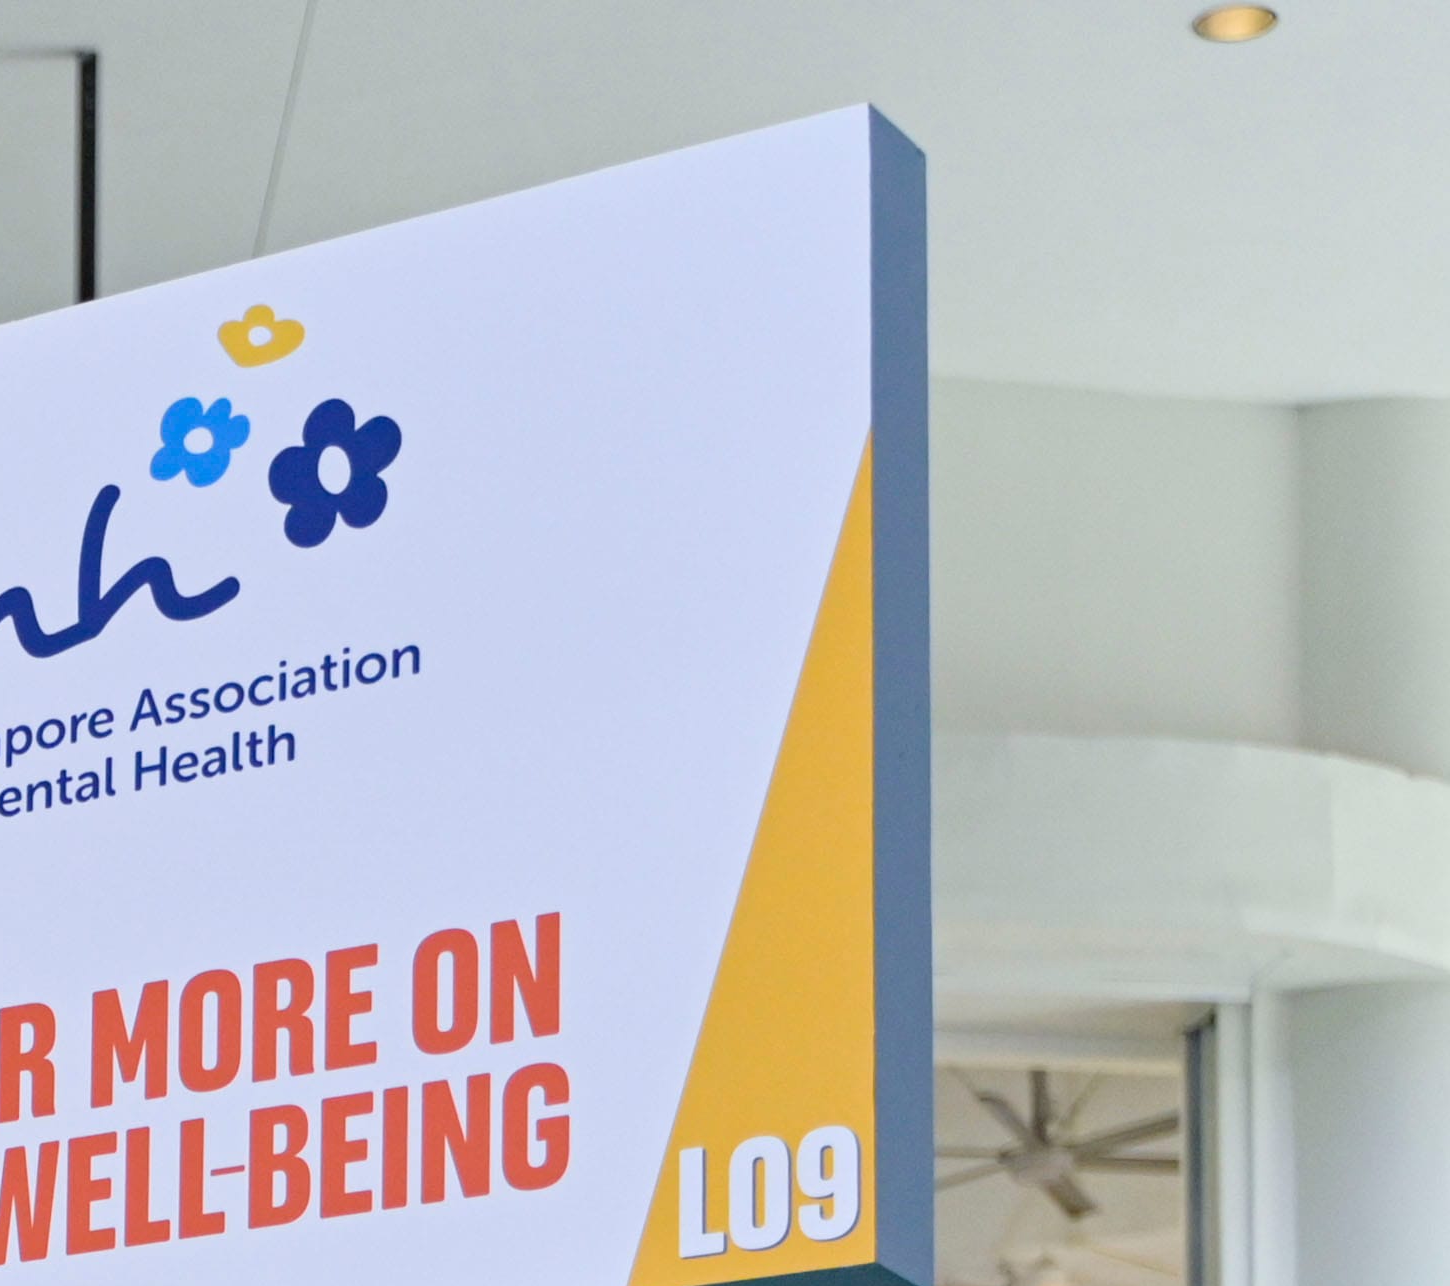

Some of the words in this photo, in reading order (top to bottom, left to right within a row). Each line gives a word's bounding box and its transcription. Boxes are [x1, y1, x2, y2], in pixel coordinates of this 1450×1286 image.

[130, 636, 423, 731] Association
[132, 723, 297, 791] Health
[90, 943, 379, 1101] MORE
[411, 911, 563, 1055] ON
